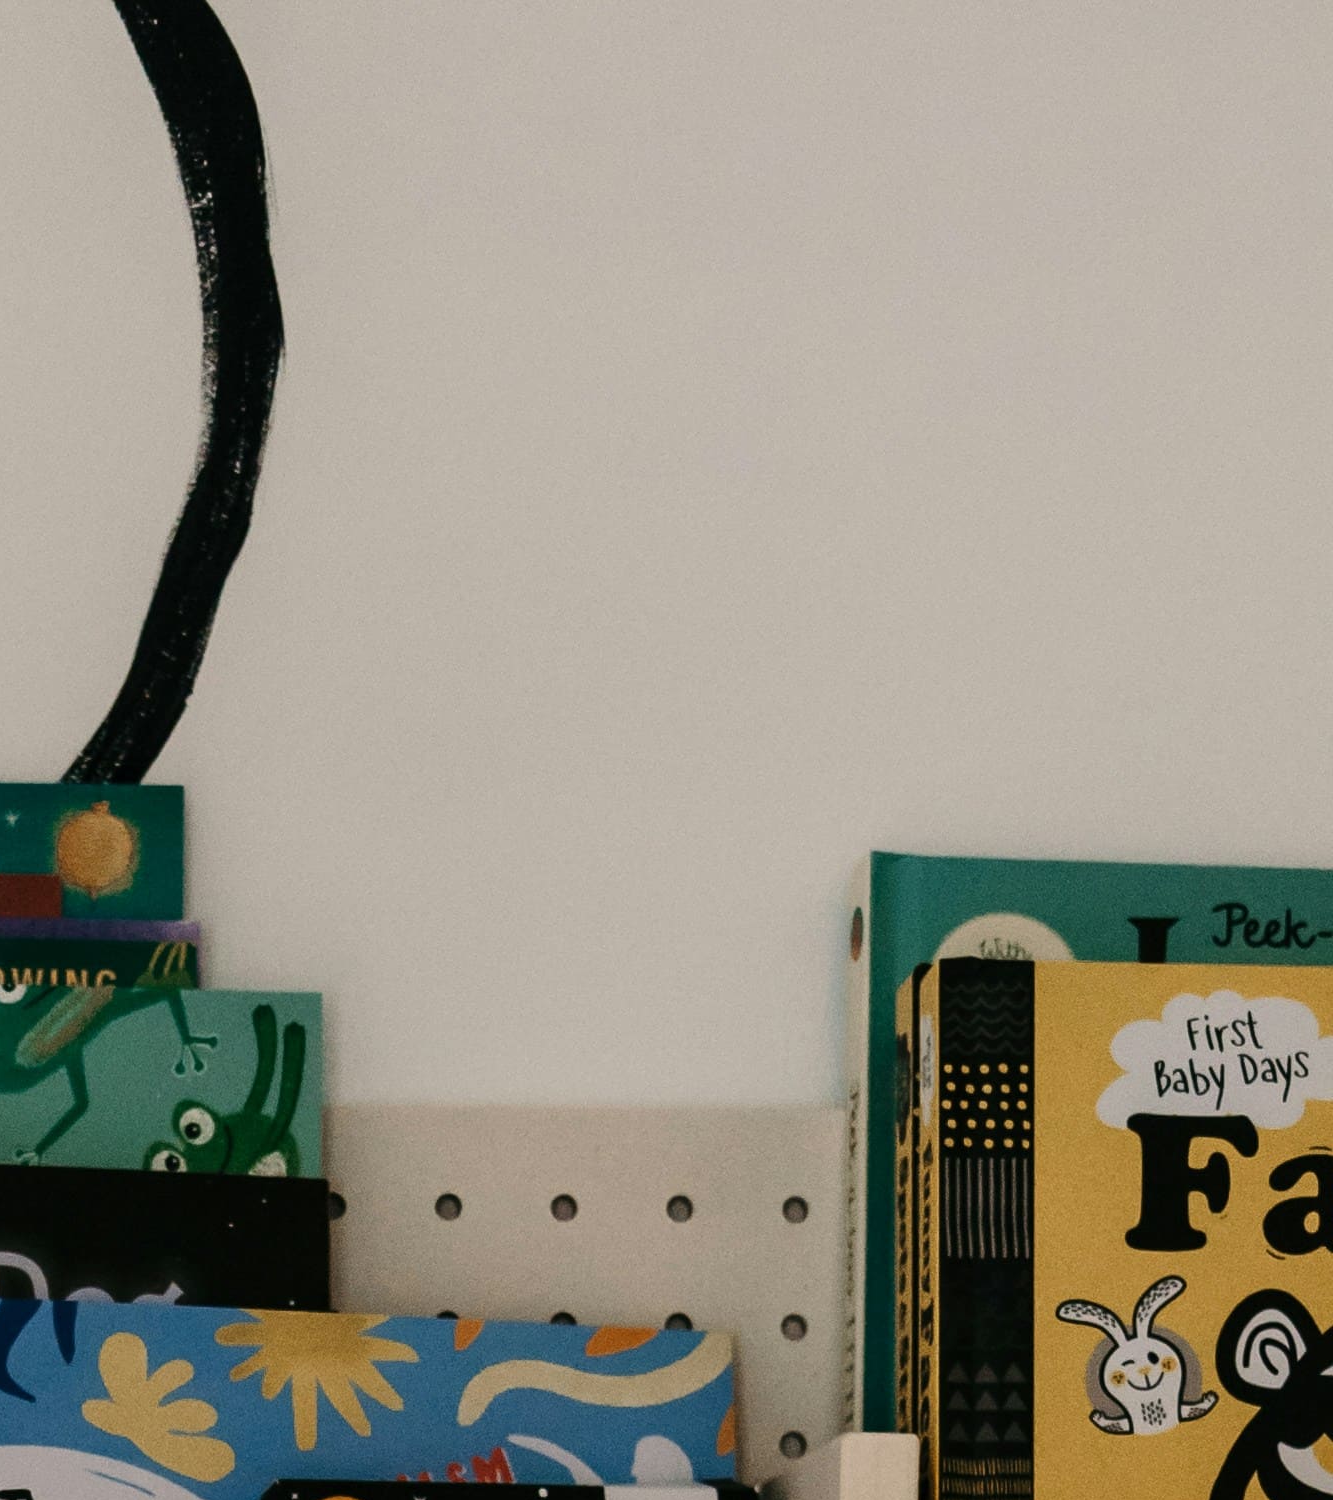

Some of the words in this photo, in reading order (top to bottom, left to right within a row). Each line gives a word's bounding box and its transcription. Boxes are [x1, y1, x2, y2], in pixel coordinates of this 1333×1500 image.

[1186, 1010, 1264, 1053] First
[1154, 1058, 1226, 1111] Baby
[1238, 1051, 1310, 1103] Days
